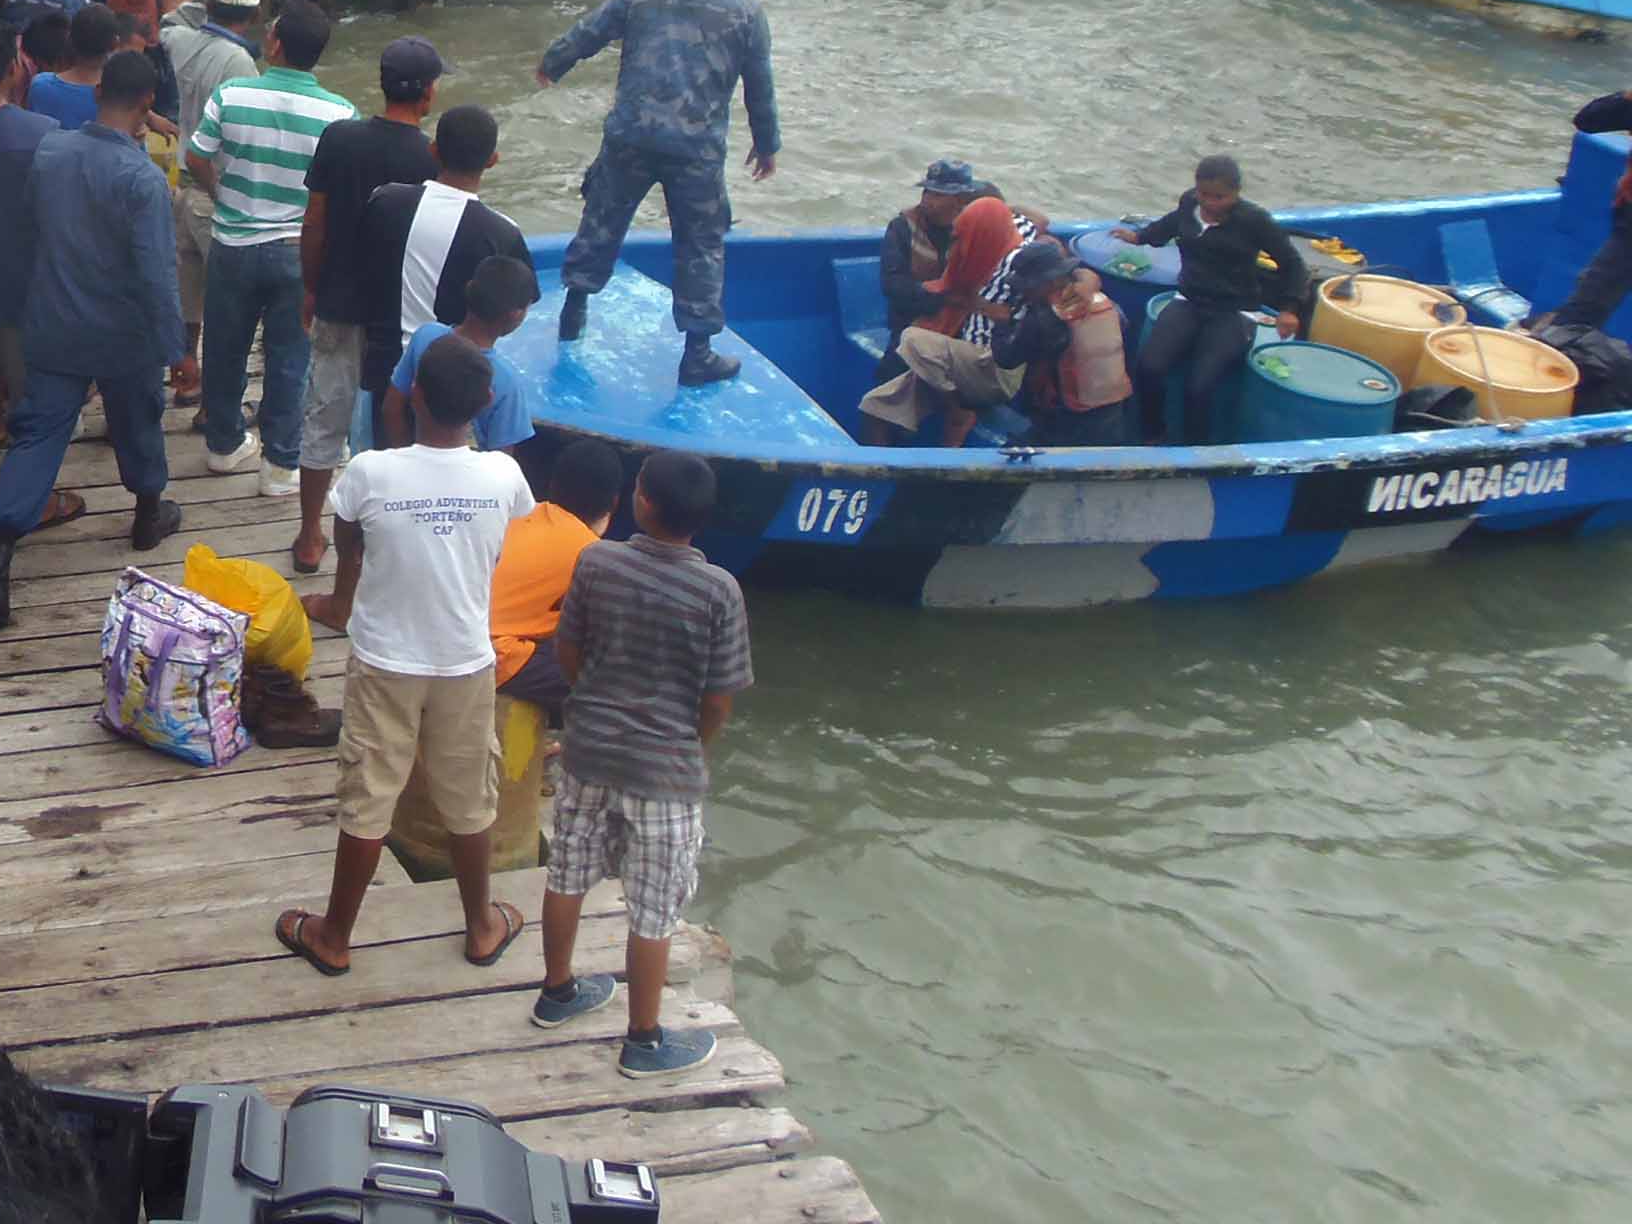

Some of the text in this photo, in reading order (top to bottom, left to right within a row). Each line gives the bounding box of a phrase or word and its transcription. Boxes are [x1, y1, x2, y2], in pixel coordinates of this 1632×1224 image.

[384, 497, 500, 512] COLEGIO ADVENTISTA
[1367, 458, 1568, 513] NICARAGUA
[798, 487, 869, 535] 079
